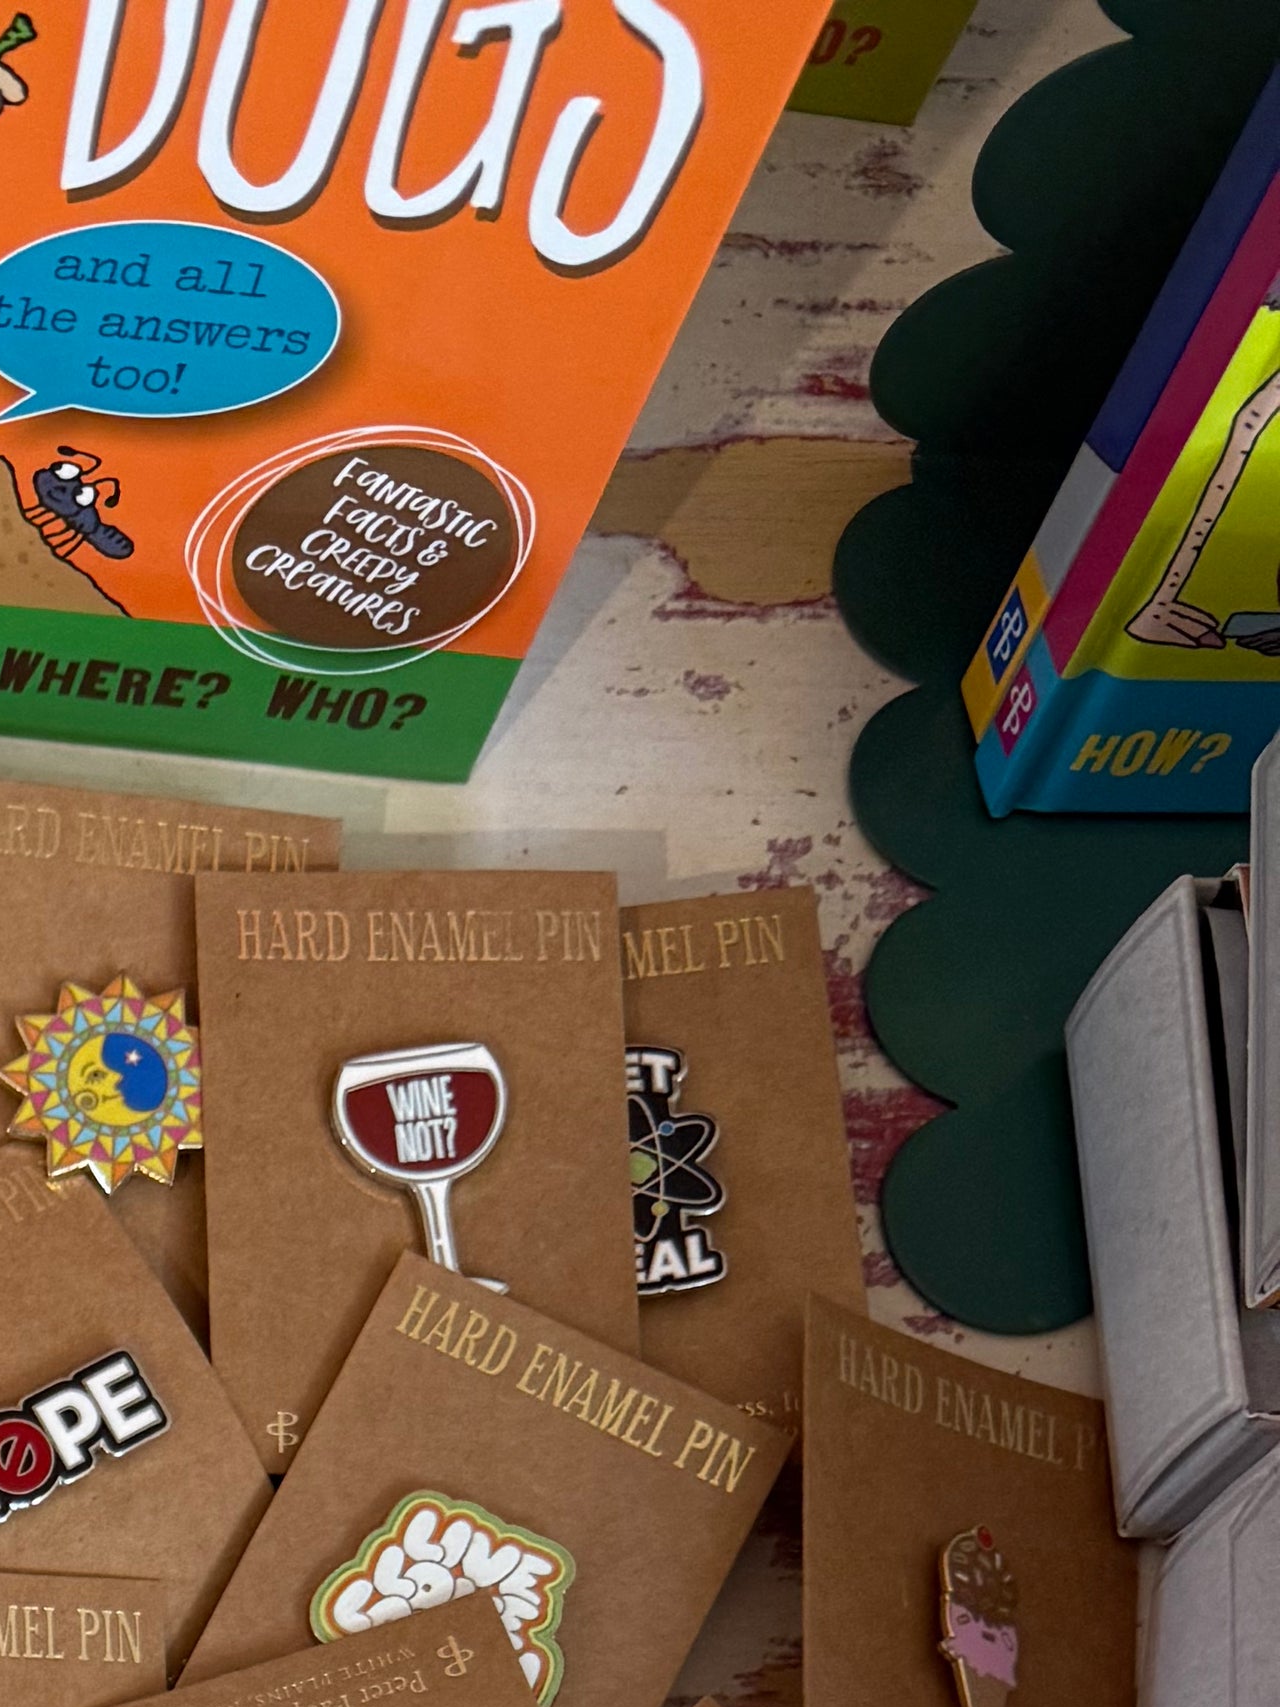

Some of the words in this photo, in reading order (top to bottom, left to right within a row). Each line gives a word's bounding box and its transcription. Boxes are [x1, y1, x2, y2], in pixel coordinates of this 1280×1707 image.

[54, 250, 151, 290] and
[174, 256, 267, 300] all
[98, 306, 311, 358] answers
[89, 354, 188, 396] too!
[422, 539, 449, 568] &
[265, 674, 428, 731] WHO?
[1069, 728, 1232, 779] HOW?
[238, 908, 351, 961] HARD
[367, 910, 524, 962] ENAMEL
[536, 910, 603, 962] PIN
[387, 1074, 457, 1124] WINE
[394, 1117, 457, 1164] NOT?
[396, 1285, 519, 1377] HARD
[515, 1342, 669, 1458] ENAMEL
[673, 1418, 756, 1494] PIN
[402, 1508, 553, 1594] LIVE
[77, 1609, 142, 1664] PIN
